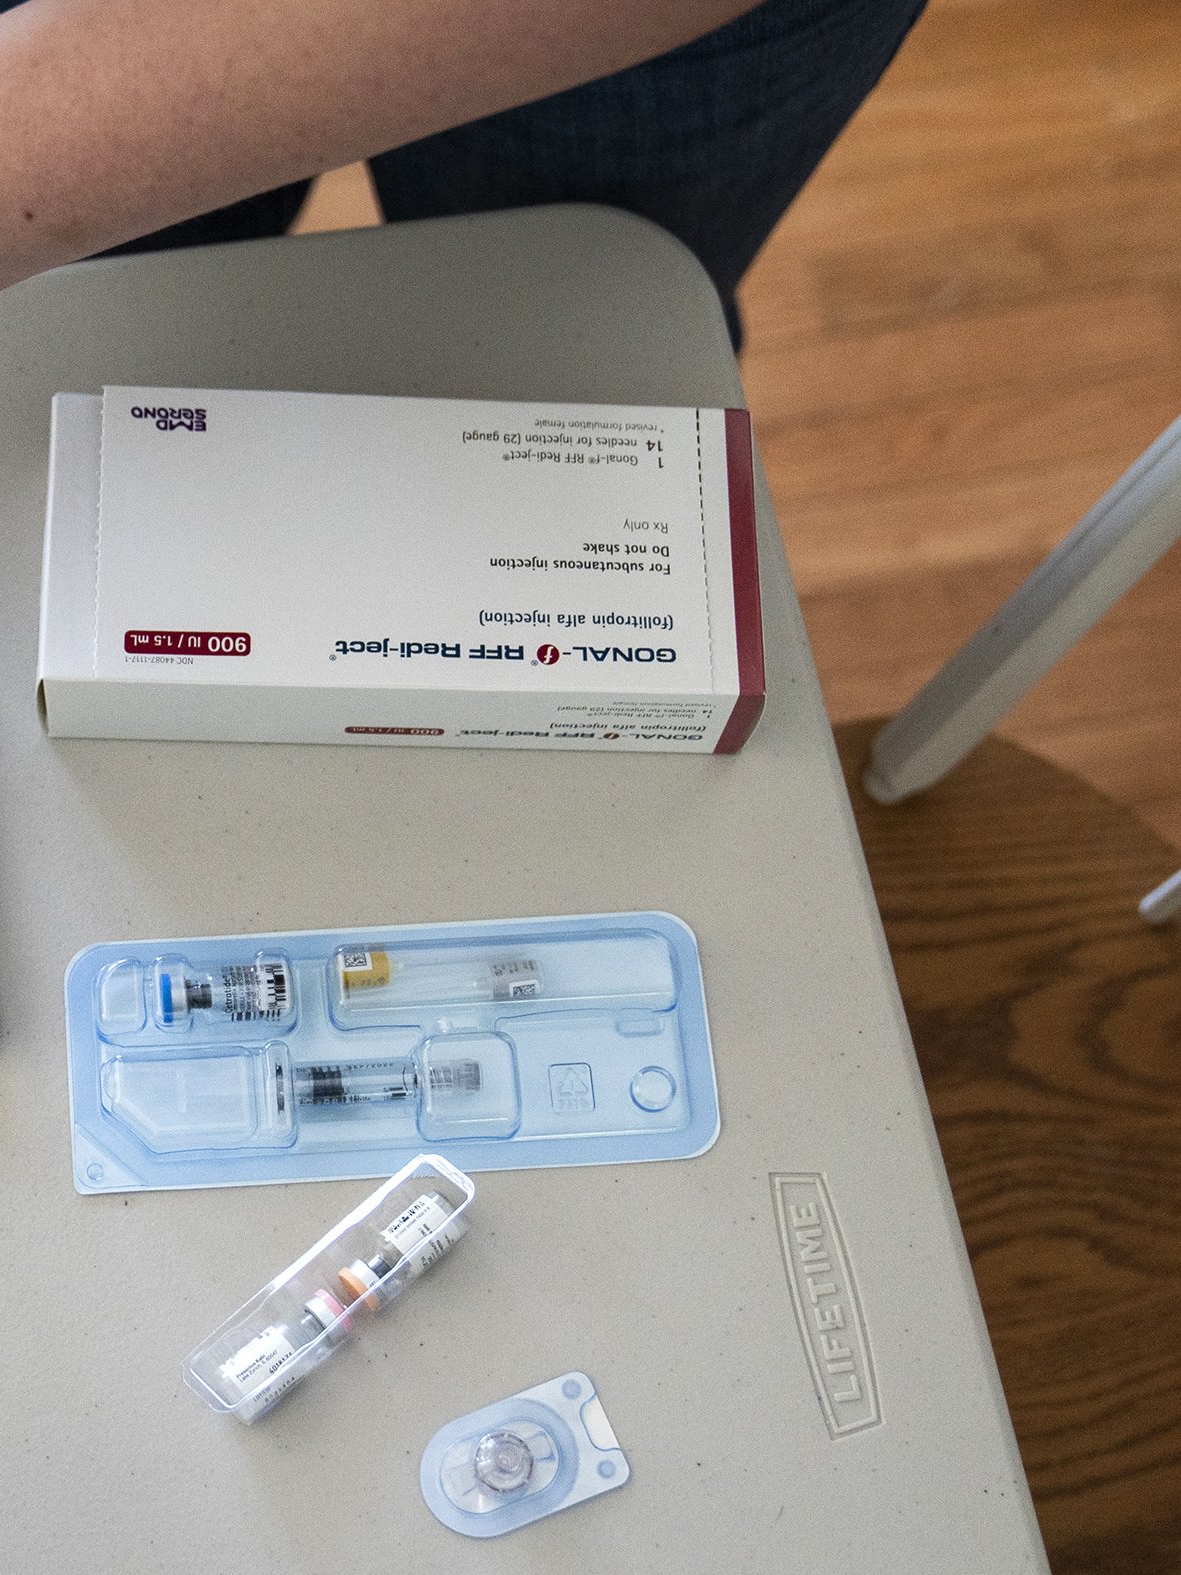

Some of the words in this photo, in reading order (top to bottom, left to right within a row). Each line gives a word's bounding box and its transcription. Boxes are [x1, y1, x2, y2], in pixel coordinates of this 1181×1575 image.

[130, 406, 206, 422] SERONO
[155, 417, 206, 432] EMD
[534, 418, 565, 429] female
[567, 420, 622, 431] formulation
[624, 422, 657, 431] revised
[461, 429, 500, 443] gauge)
[502, 432, 521, 445] (29
[524, 432, 572, 446] injection
[576, 435, 592, 447] for
[595, 436, 637, 448] needles
[645, 439, 663, 452] 14
[501, 448, 561, 463] Redi-ject®
[565, 452, 584, 463] RFF
[587, 453, 638, 466] Gonal-f®
[657, 456, 664, 469] 1
[622, 517, 649, 532] only
[652, 521, 668, 534] Rx
[582, 542, 620, 555] shake
[624, 543, 647, 555] not
[651, 545, 670, 557] Do
[489, 555, 548, 571] injection
[552, 559, 644, 573] subcutaneous
[648, 562, 671, 575] For
[478, 609, 550, 627] injection)
[556, 613, 585, 628] alfa
[591, 611, 673, 630] (follitropin
[129, 633, 149, 646] mL
[153, 634, 172, 646] 1.5
[176, 633, 184, 648] /
[187, 635, 201, 647] IU
[207, 635, 246, 652] 900
[468, 644, 524, 660] RFF
[124, 655, 174, 664] 44087-1117-1
[176, 656, 193, 665] NDC
[549, 721, 608, 729] injection)
[640, 723, 706, 732] (follitropin
[790, 1200, 861, 1403] LIFETIME
[235, 1361, 256, 1379] Fresenius
[254, 1353, 266, 1363] Kabi
